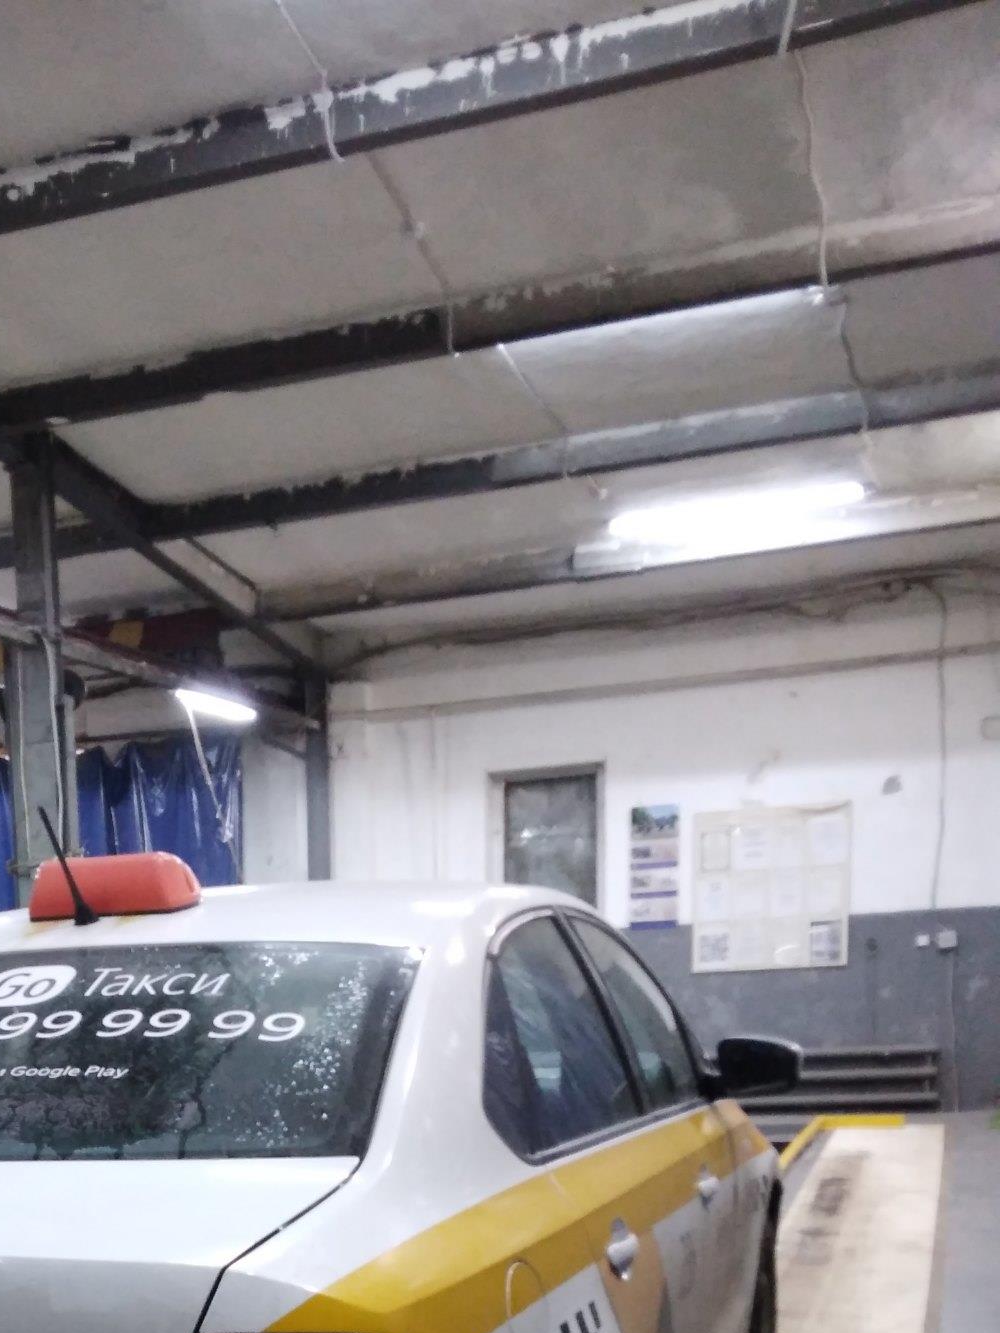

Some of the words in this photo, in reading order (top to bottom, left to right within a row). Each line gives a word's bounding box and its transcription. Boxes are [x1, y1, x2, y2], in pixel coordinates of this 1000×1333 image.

[84, 967, 231, 997] Такси
[95, 1008, 192, 1038] 99
[207, 1009, 306, 1042] 99
[10, 1065, 81, 1079] Google
[84, 1065, 129, 1080] Play
